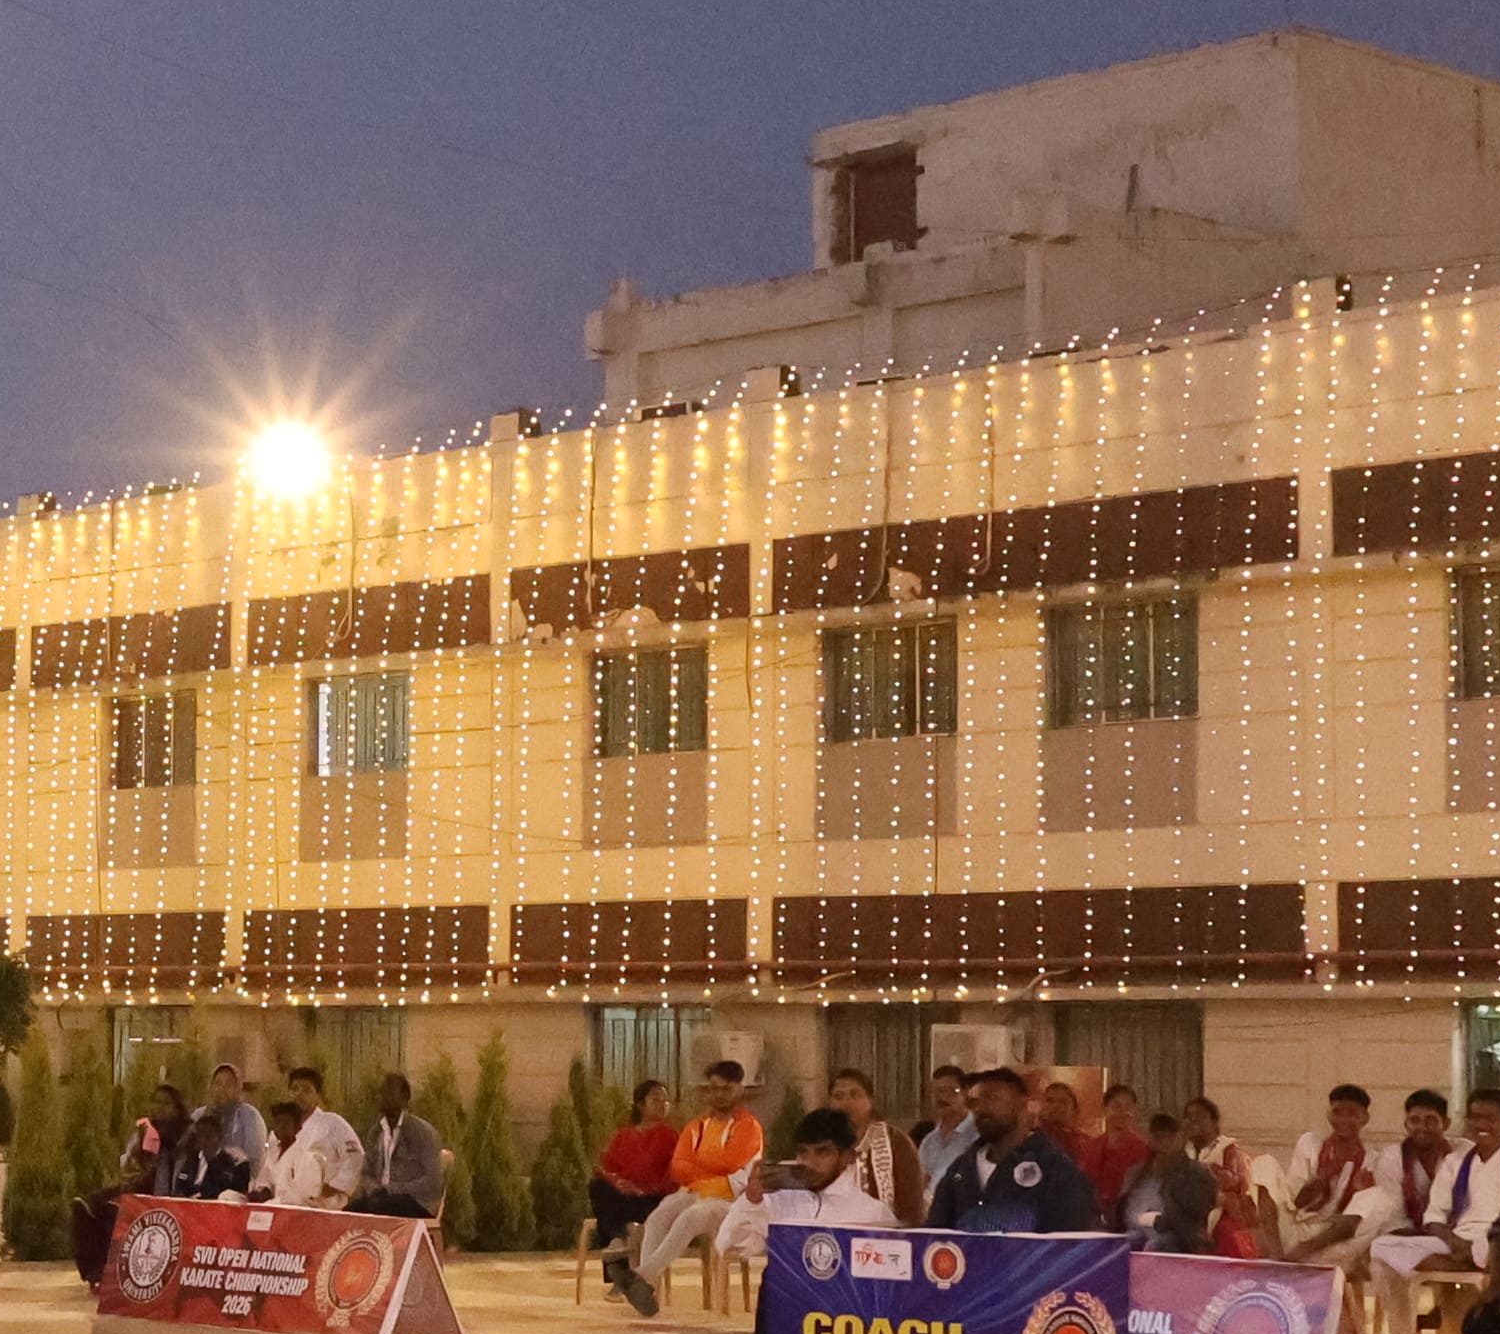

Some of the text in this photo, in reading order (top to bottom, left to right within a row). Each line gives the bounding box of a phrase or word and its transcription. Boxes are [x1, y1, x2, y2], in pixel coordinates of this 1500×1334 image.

[192, 1245, 307, 1274] SVU OPEN NATIONAL
[180, 1267, 225, 1289] KARATE
[221, 1294, 253, 1316] 2026
